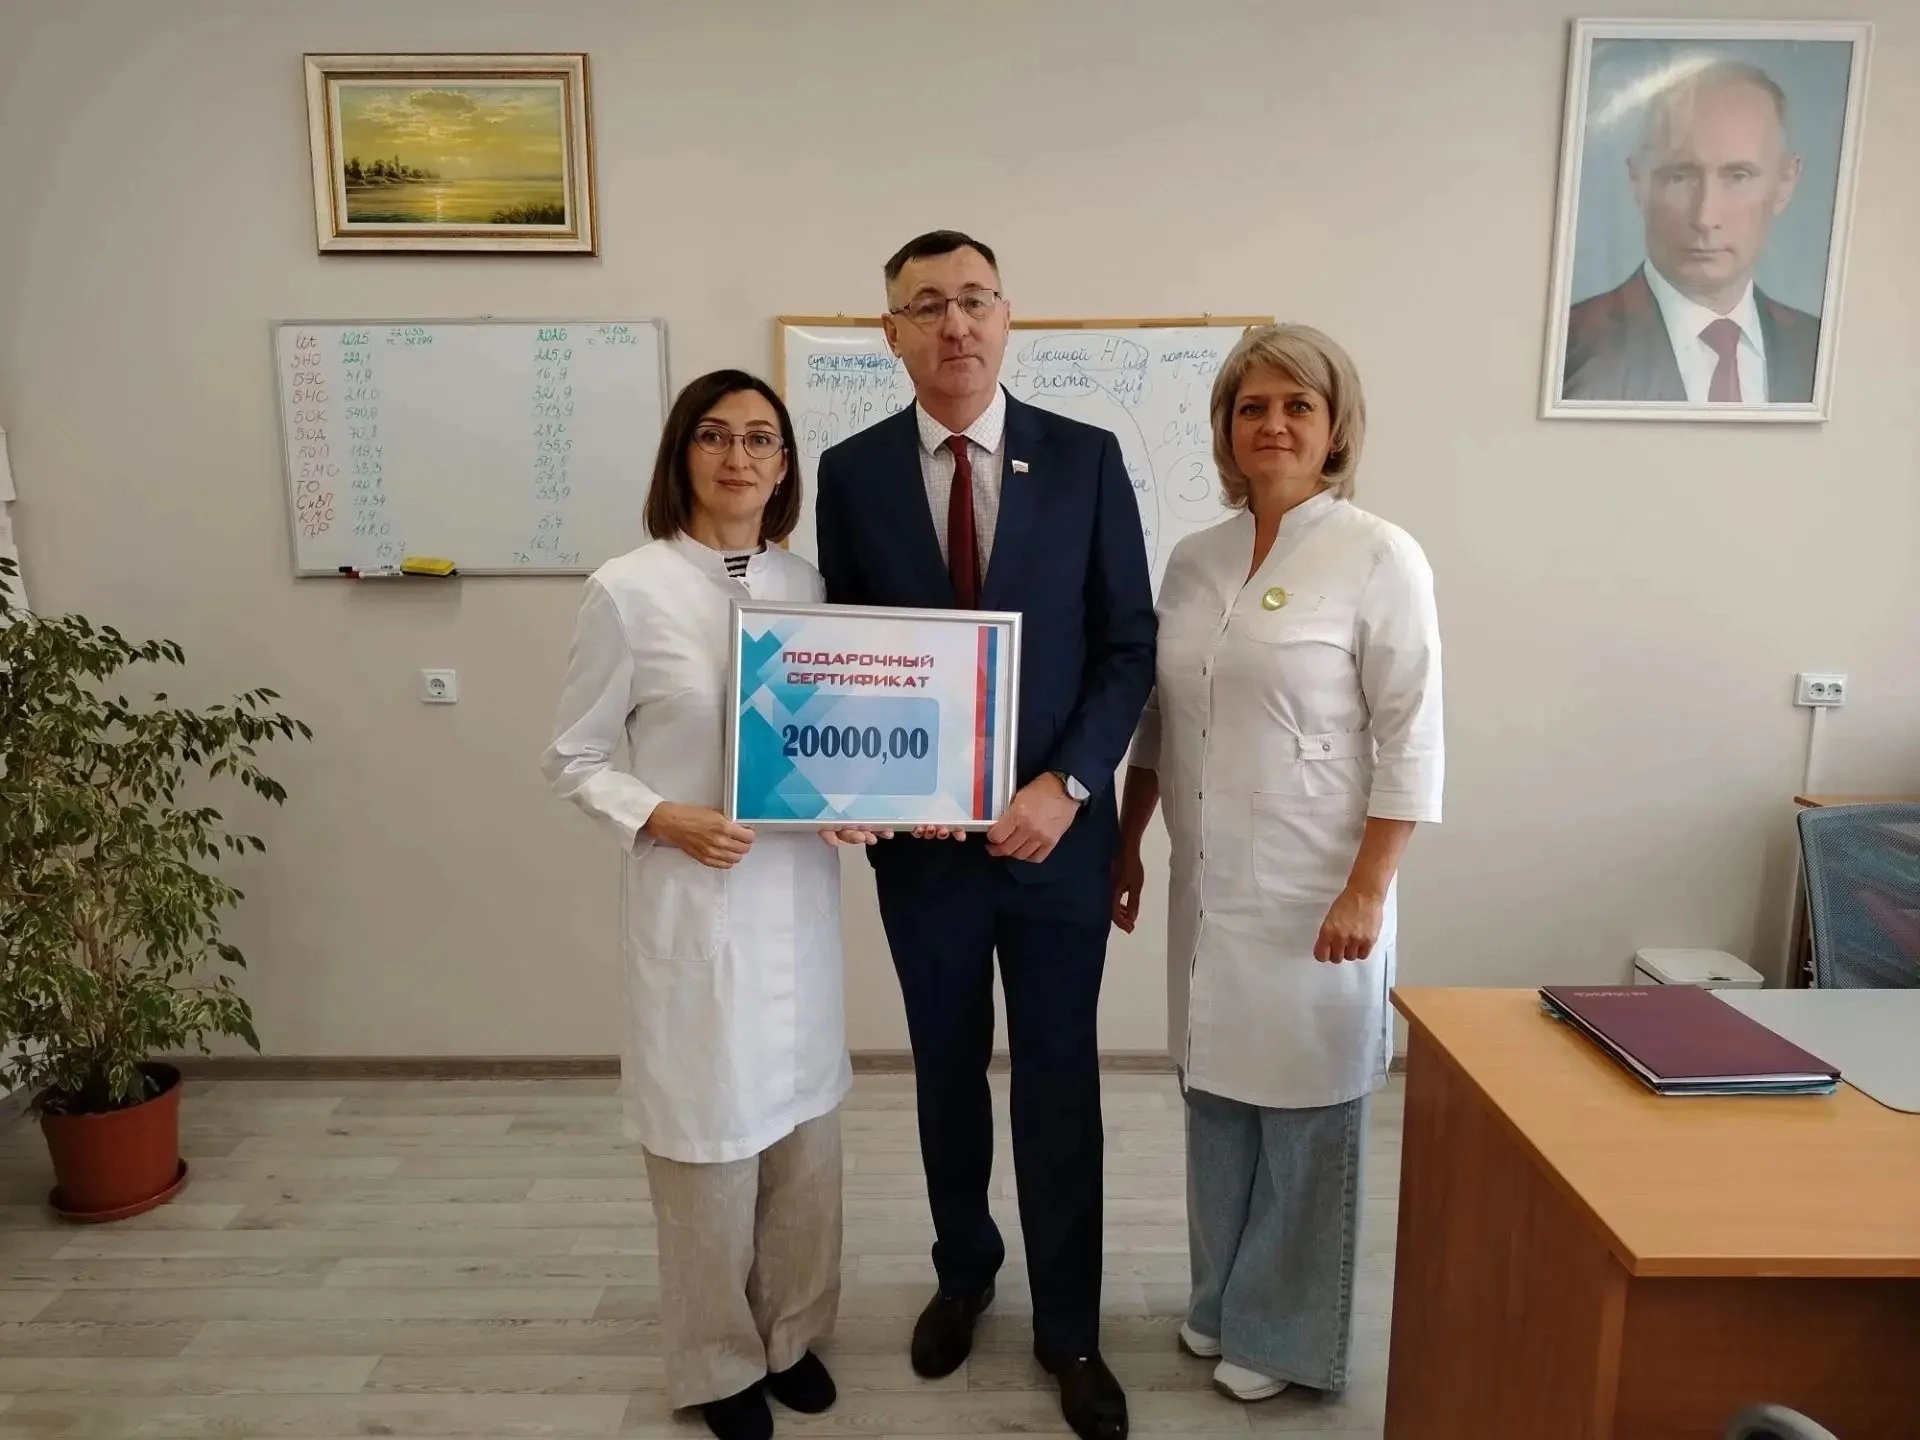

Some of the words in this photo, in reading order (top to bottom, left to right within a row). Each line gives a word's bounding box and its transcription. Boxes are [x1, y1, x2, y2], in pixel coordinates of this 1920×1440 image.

[1178, 462, 1211, 502] 3
[782, 651, 934, 669] ПОДАРОЧНЫЙ
[787, 671, 930, 689] СЕРТИФИКАТ
[782, 724, 929, 764] 20000,00
